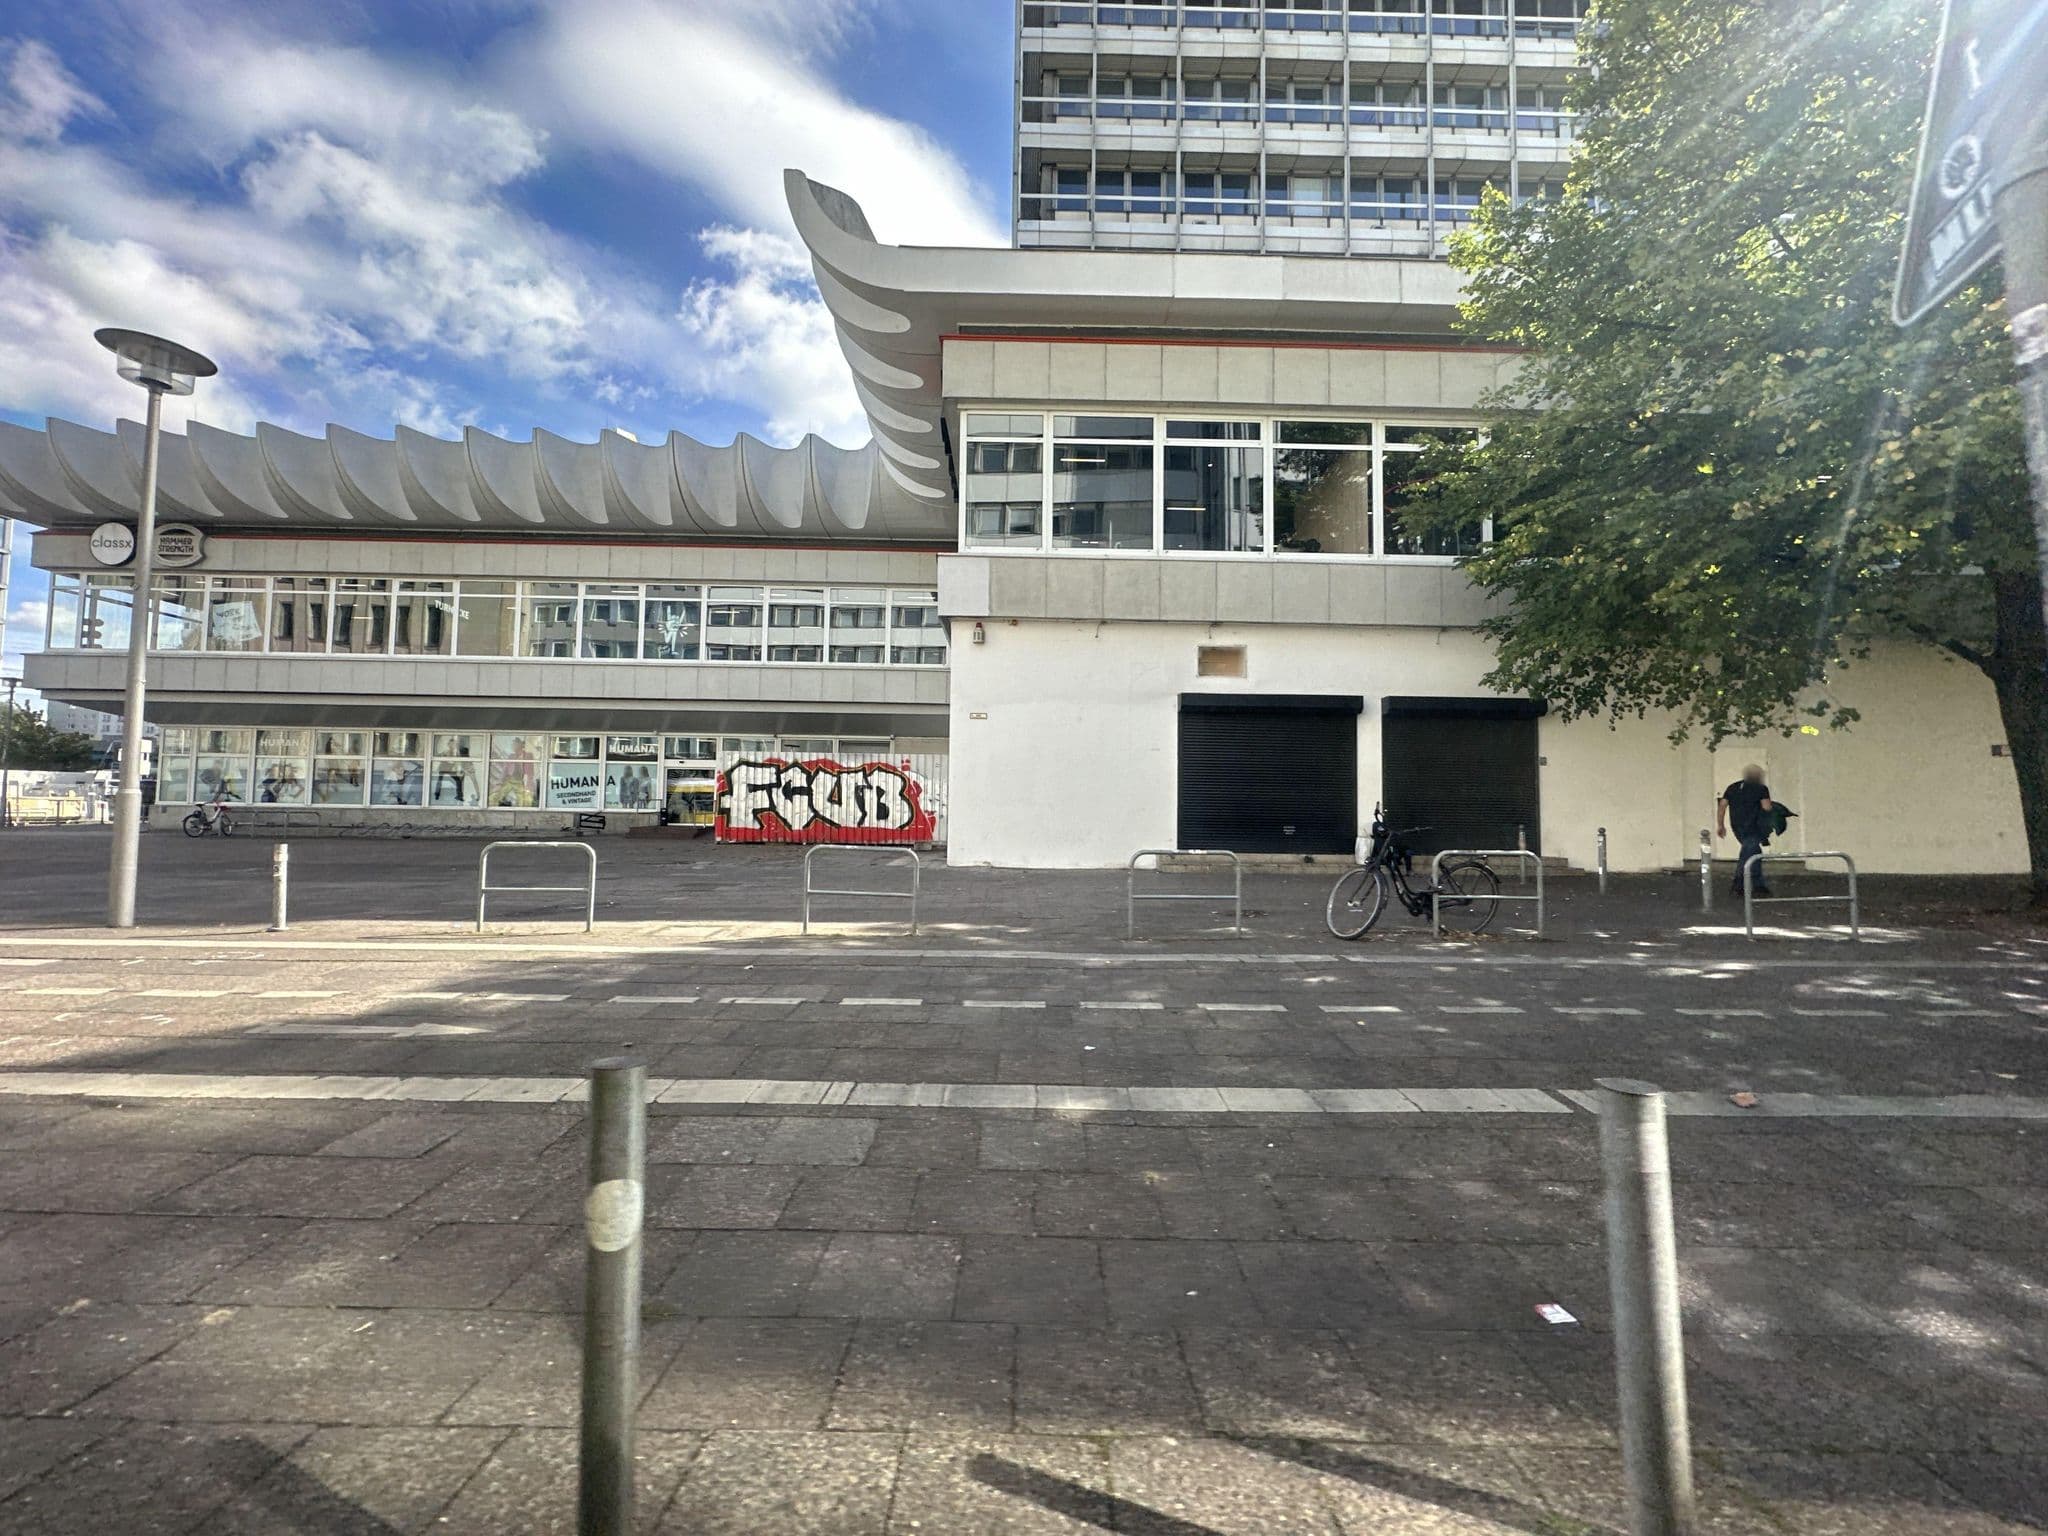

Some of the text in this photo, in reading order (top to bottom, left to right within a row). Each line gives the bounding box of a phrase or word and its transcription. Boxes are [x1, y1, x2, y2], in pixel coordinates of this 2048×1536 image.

[91, 535, 132, 549] classx
[158, 545, 194, 553] STRENGTH
[609, 744, 656, 753] HUMANA
[551, 775, 616, 790] HUMANA
[556, 790, 597, 799] SECONDHAND
